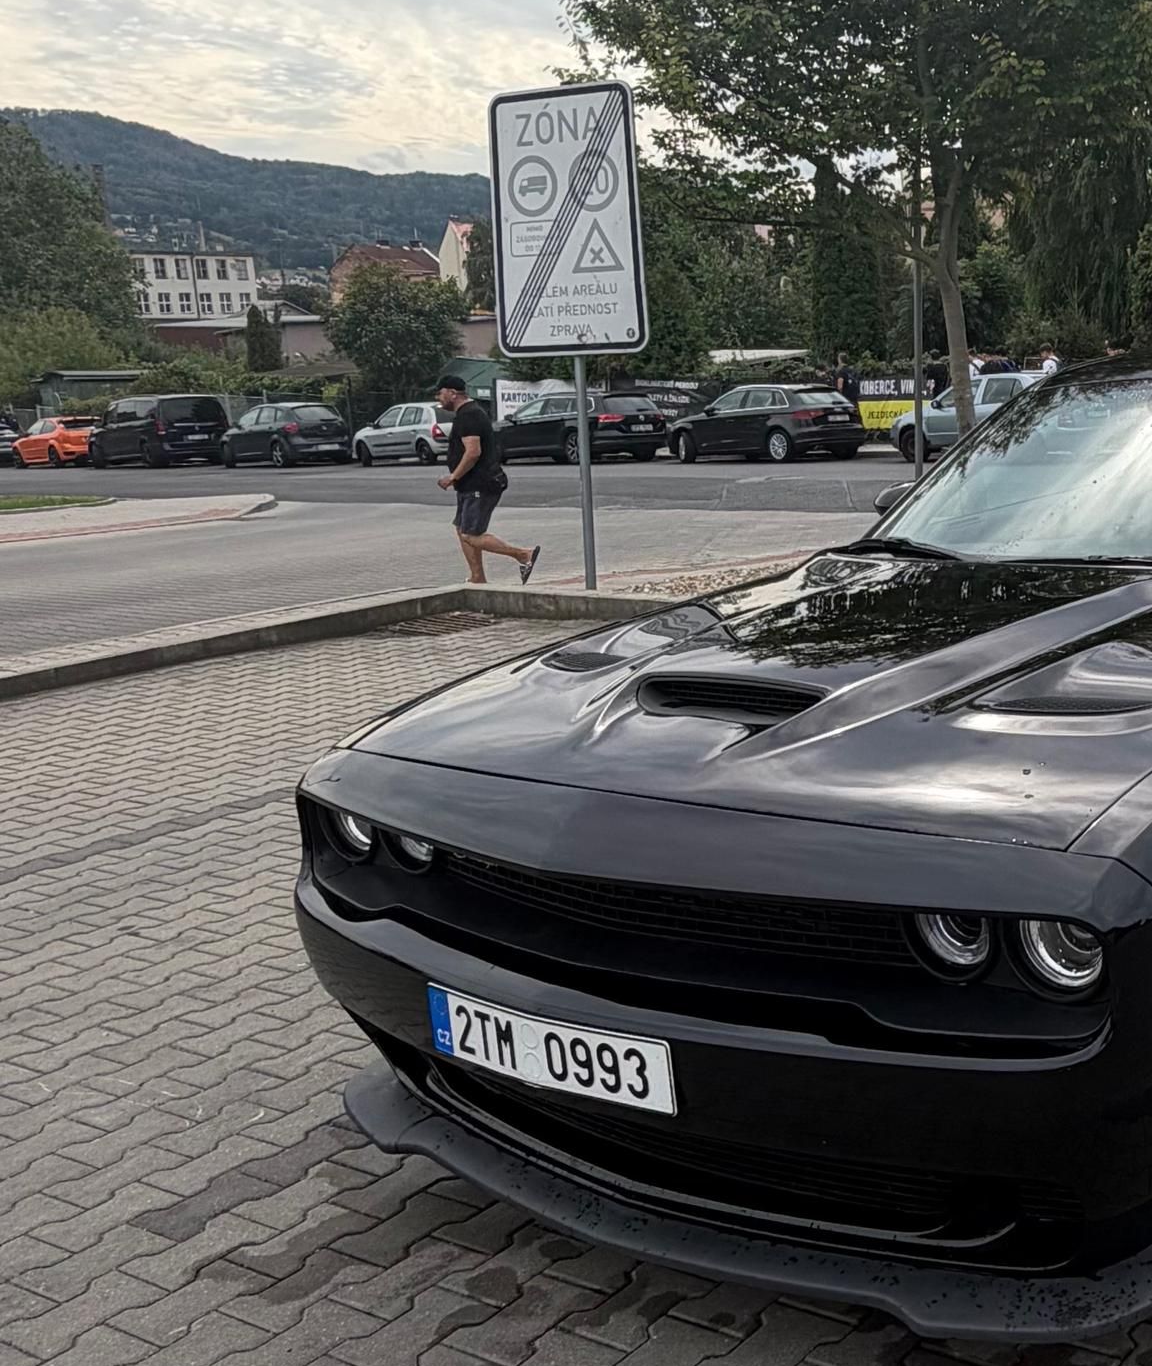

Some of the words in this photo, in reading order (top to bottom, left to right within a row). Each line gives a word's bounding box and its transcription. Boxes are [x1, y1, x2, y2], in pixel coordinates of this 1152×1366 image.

[514, 102, 601, 147] ZÓNA
[572, 281, 618, 296] AREÁLU
[557, 302, 618, 317] PŘEDNOST
[550, 324, 594, 337] ZPRAVA
[437, 1028, 452, 1045] CZ
[455, 1005, 517, 1071] 2TM
[544, 1032, 650, 1100] 0993
